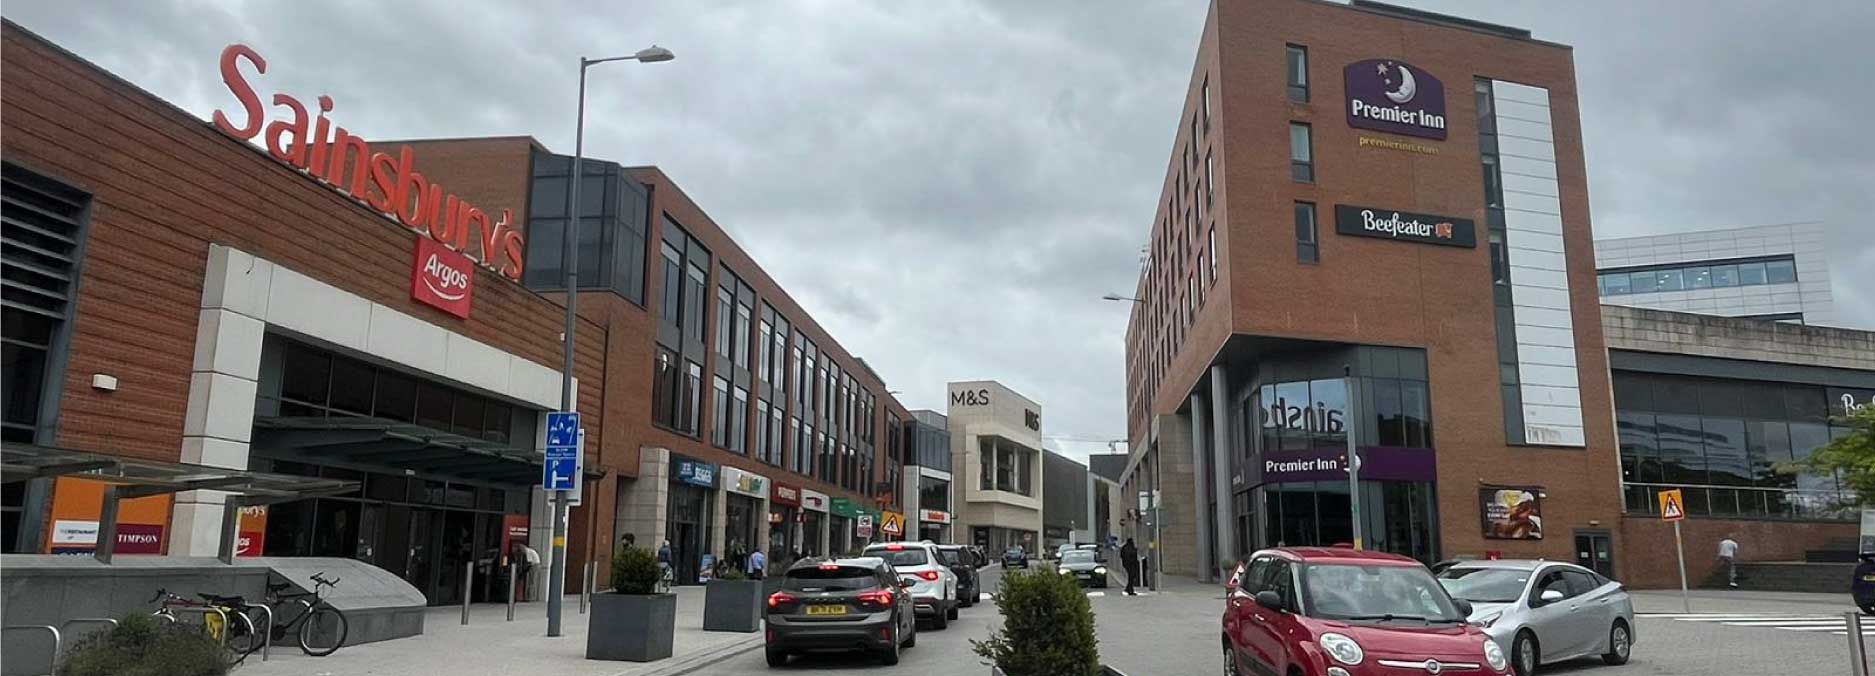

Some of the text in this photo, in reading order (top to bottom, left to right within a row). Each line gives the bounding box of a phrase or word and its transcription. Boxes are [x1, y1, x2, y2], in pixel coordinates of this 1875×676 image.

[1352, 99, 1445, 129] Premier Inn
[1359, 136, 1440, 156] premierinn.com
[212, 43, 524, 282] Sainsbury's
[1361, 209, 1434, 238] Beefeater
[423, 253, 468, 290] Argos
[951, 388, 989, 406] M&S
[1265, 458, 1337, 473] Premier Inn
[118, 533, 158, 544] TIMPSON
